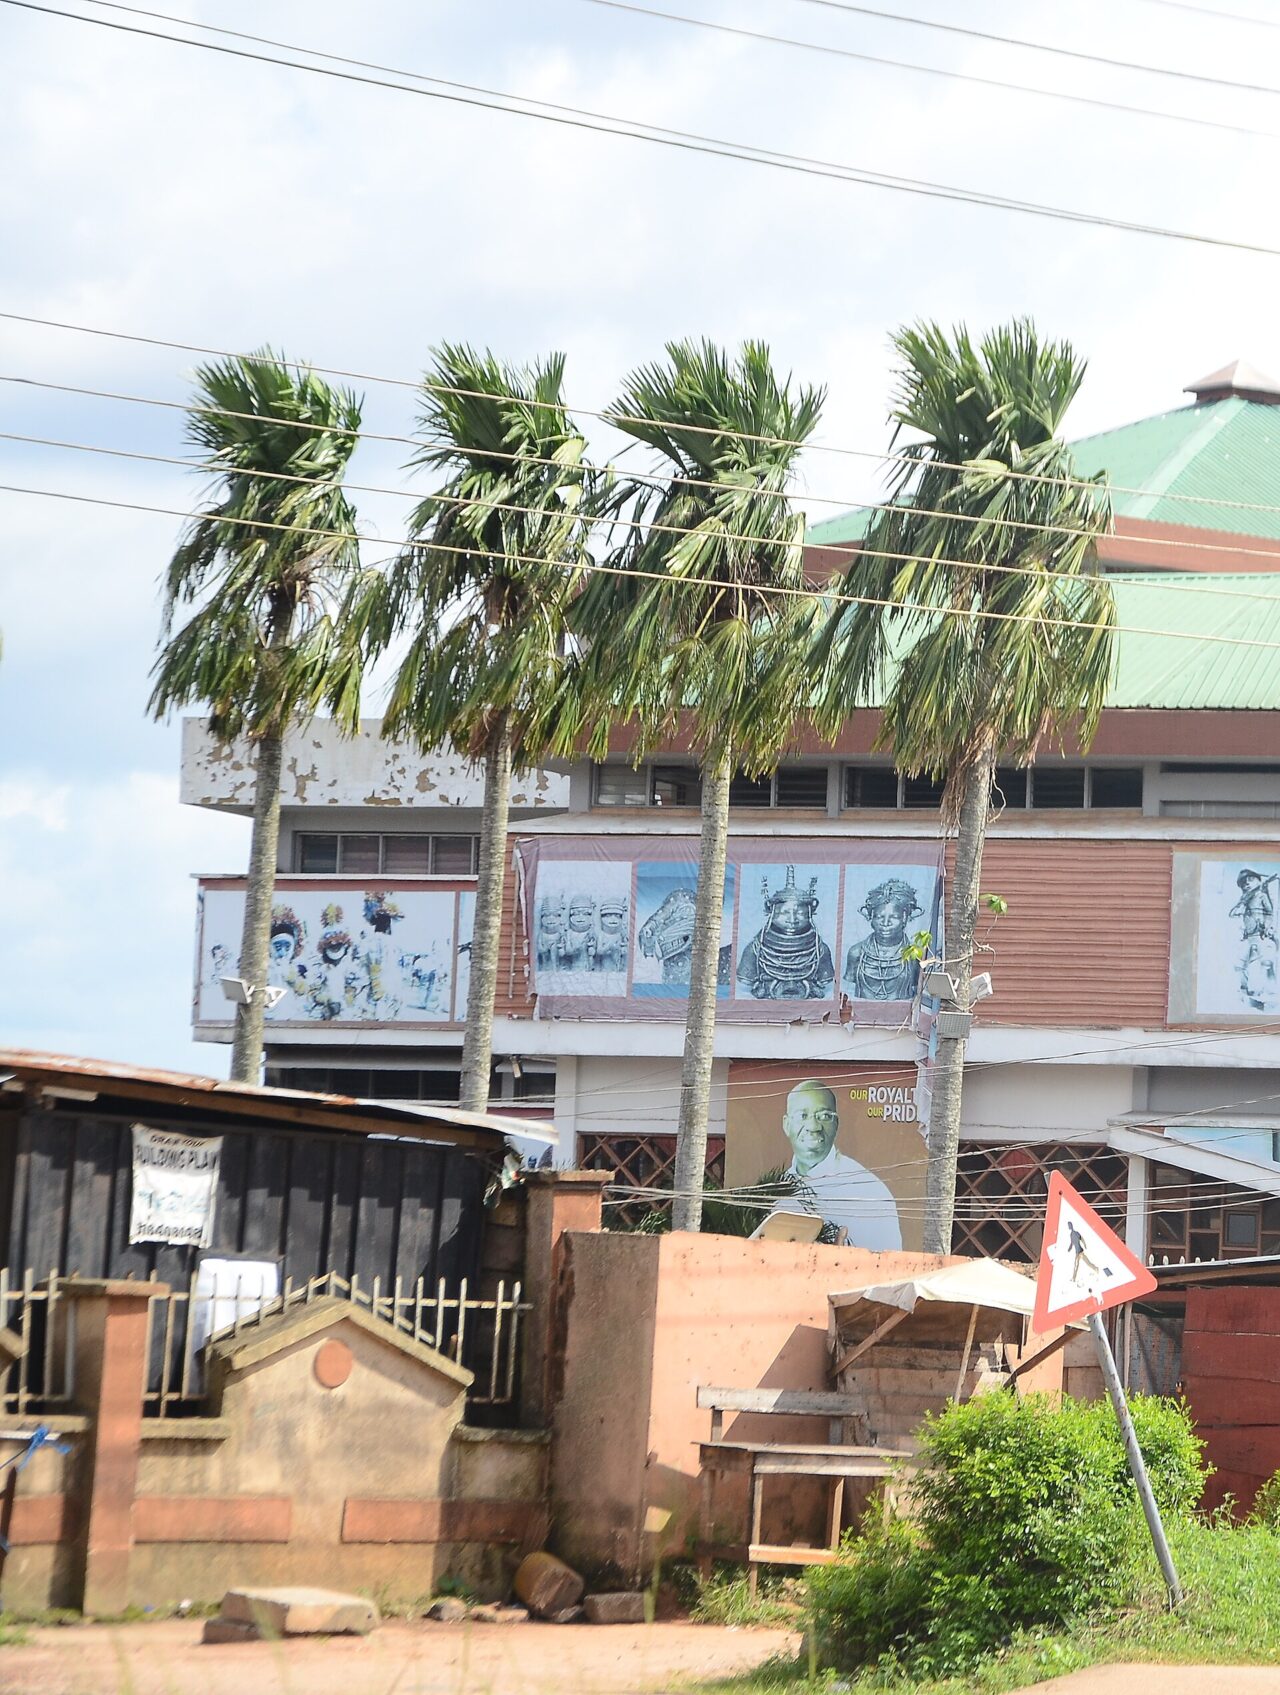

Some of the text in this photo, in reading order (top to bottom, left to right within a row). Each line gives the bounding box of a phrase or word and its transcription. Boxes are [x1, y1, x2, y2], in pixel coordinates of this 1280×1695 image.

[850, 1086, 917, 1103] OUR ROYALT
[867, 1104, 920, 1121] OUR PRID
[135, 1145, 186, 1169] BUILDING
